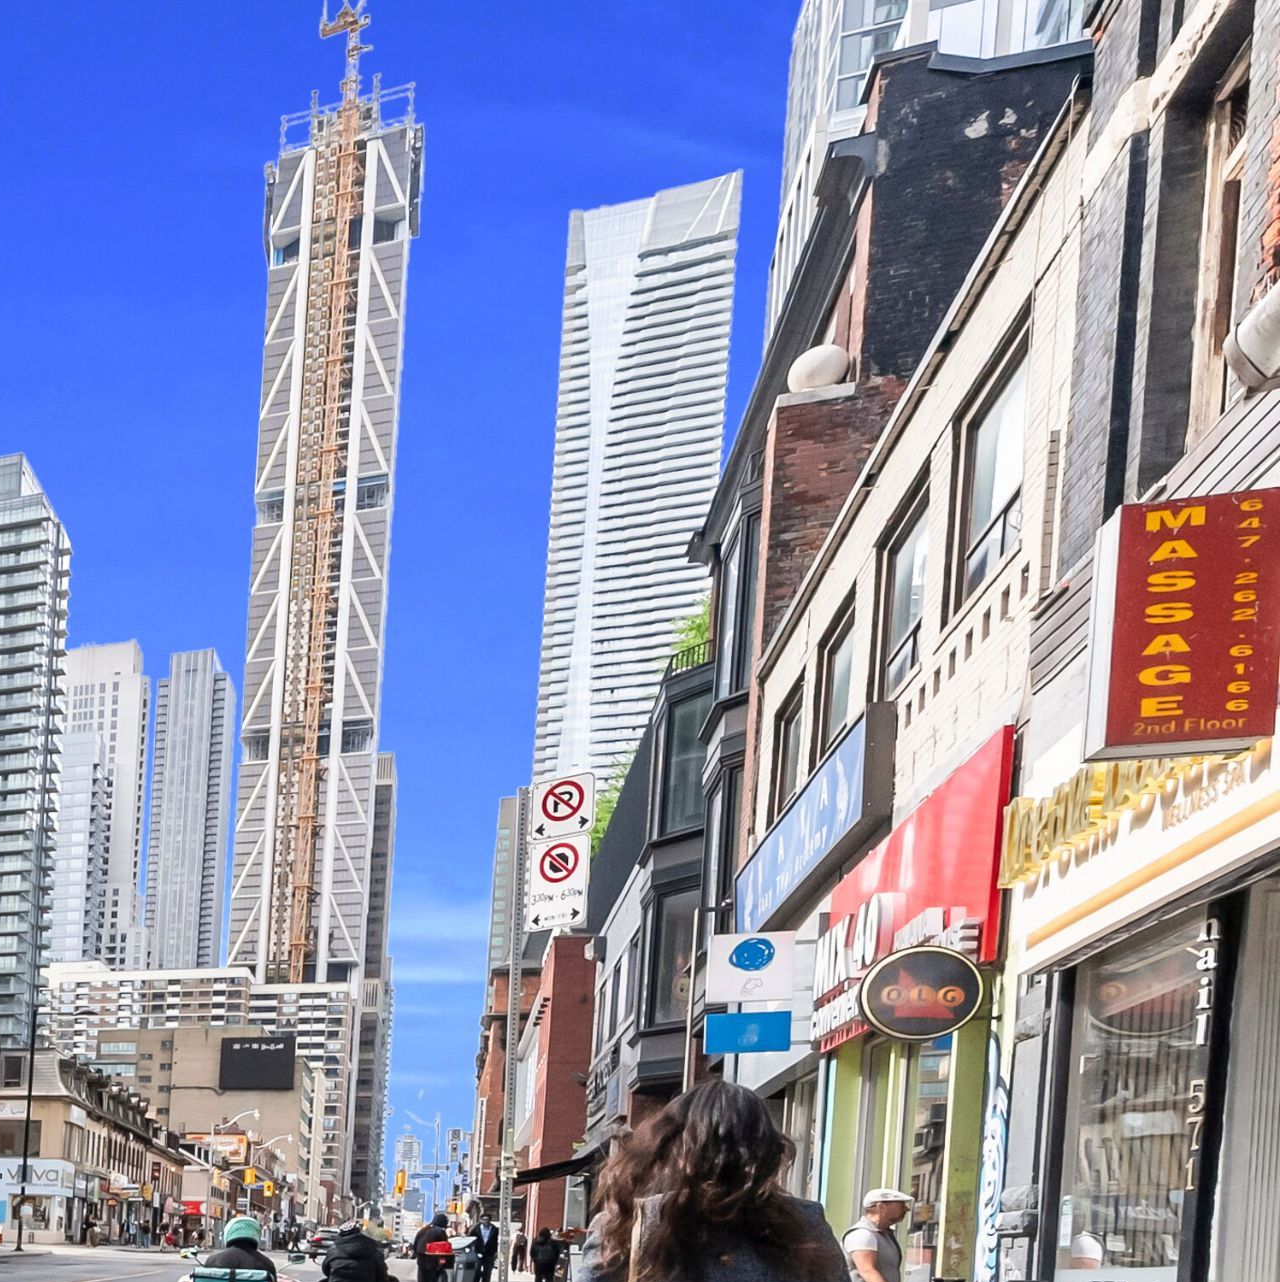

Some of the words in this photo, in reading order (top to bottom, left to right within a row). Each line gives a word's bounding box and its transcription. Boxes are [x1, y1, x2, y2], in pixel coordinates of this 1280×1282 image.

[1138, 505, 1207, 718] MASSAGE
[1133, 719, 1176, 737] 2nd
[1184, 716, 1248, 733] Floor
[1194, 916, 1221, 1046] nail
[7, 1167, 59, 1182] vva
[1184, 1079, 1206, 1191] 571
